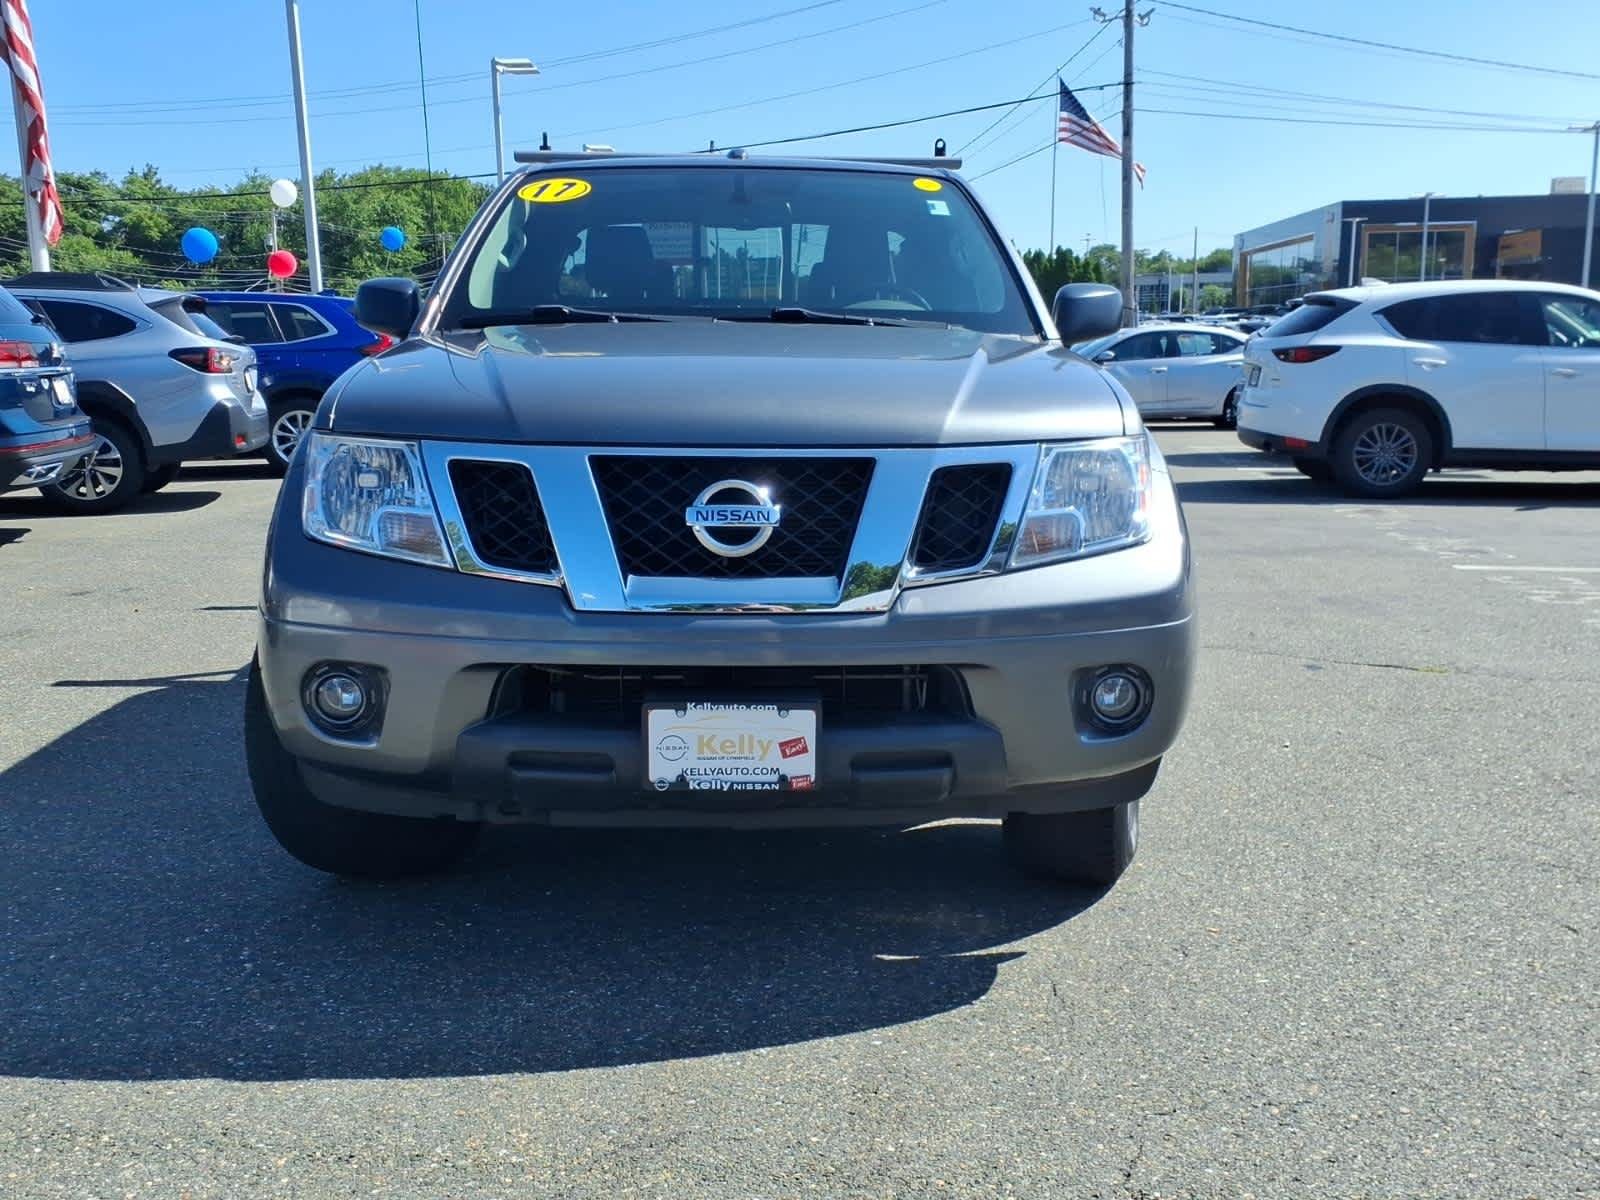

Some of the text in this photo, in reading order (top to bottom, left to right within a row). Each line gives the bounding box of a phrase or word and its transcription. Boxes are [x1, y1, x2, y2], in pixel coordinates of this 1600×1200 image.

[533, 183, 576, 197] 17
[695, 510, 770, 521] NISSAN
[686, 702, 778, 711] Kellyauto.com
[697, 734, 773, 761] Kelly
[682, 767, 780, 776] KELLYAUTO.COM
[689, 779, 732, 791] Kelly
